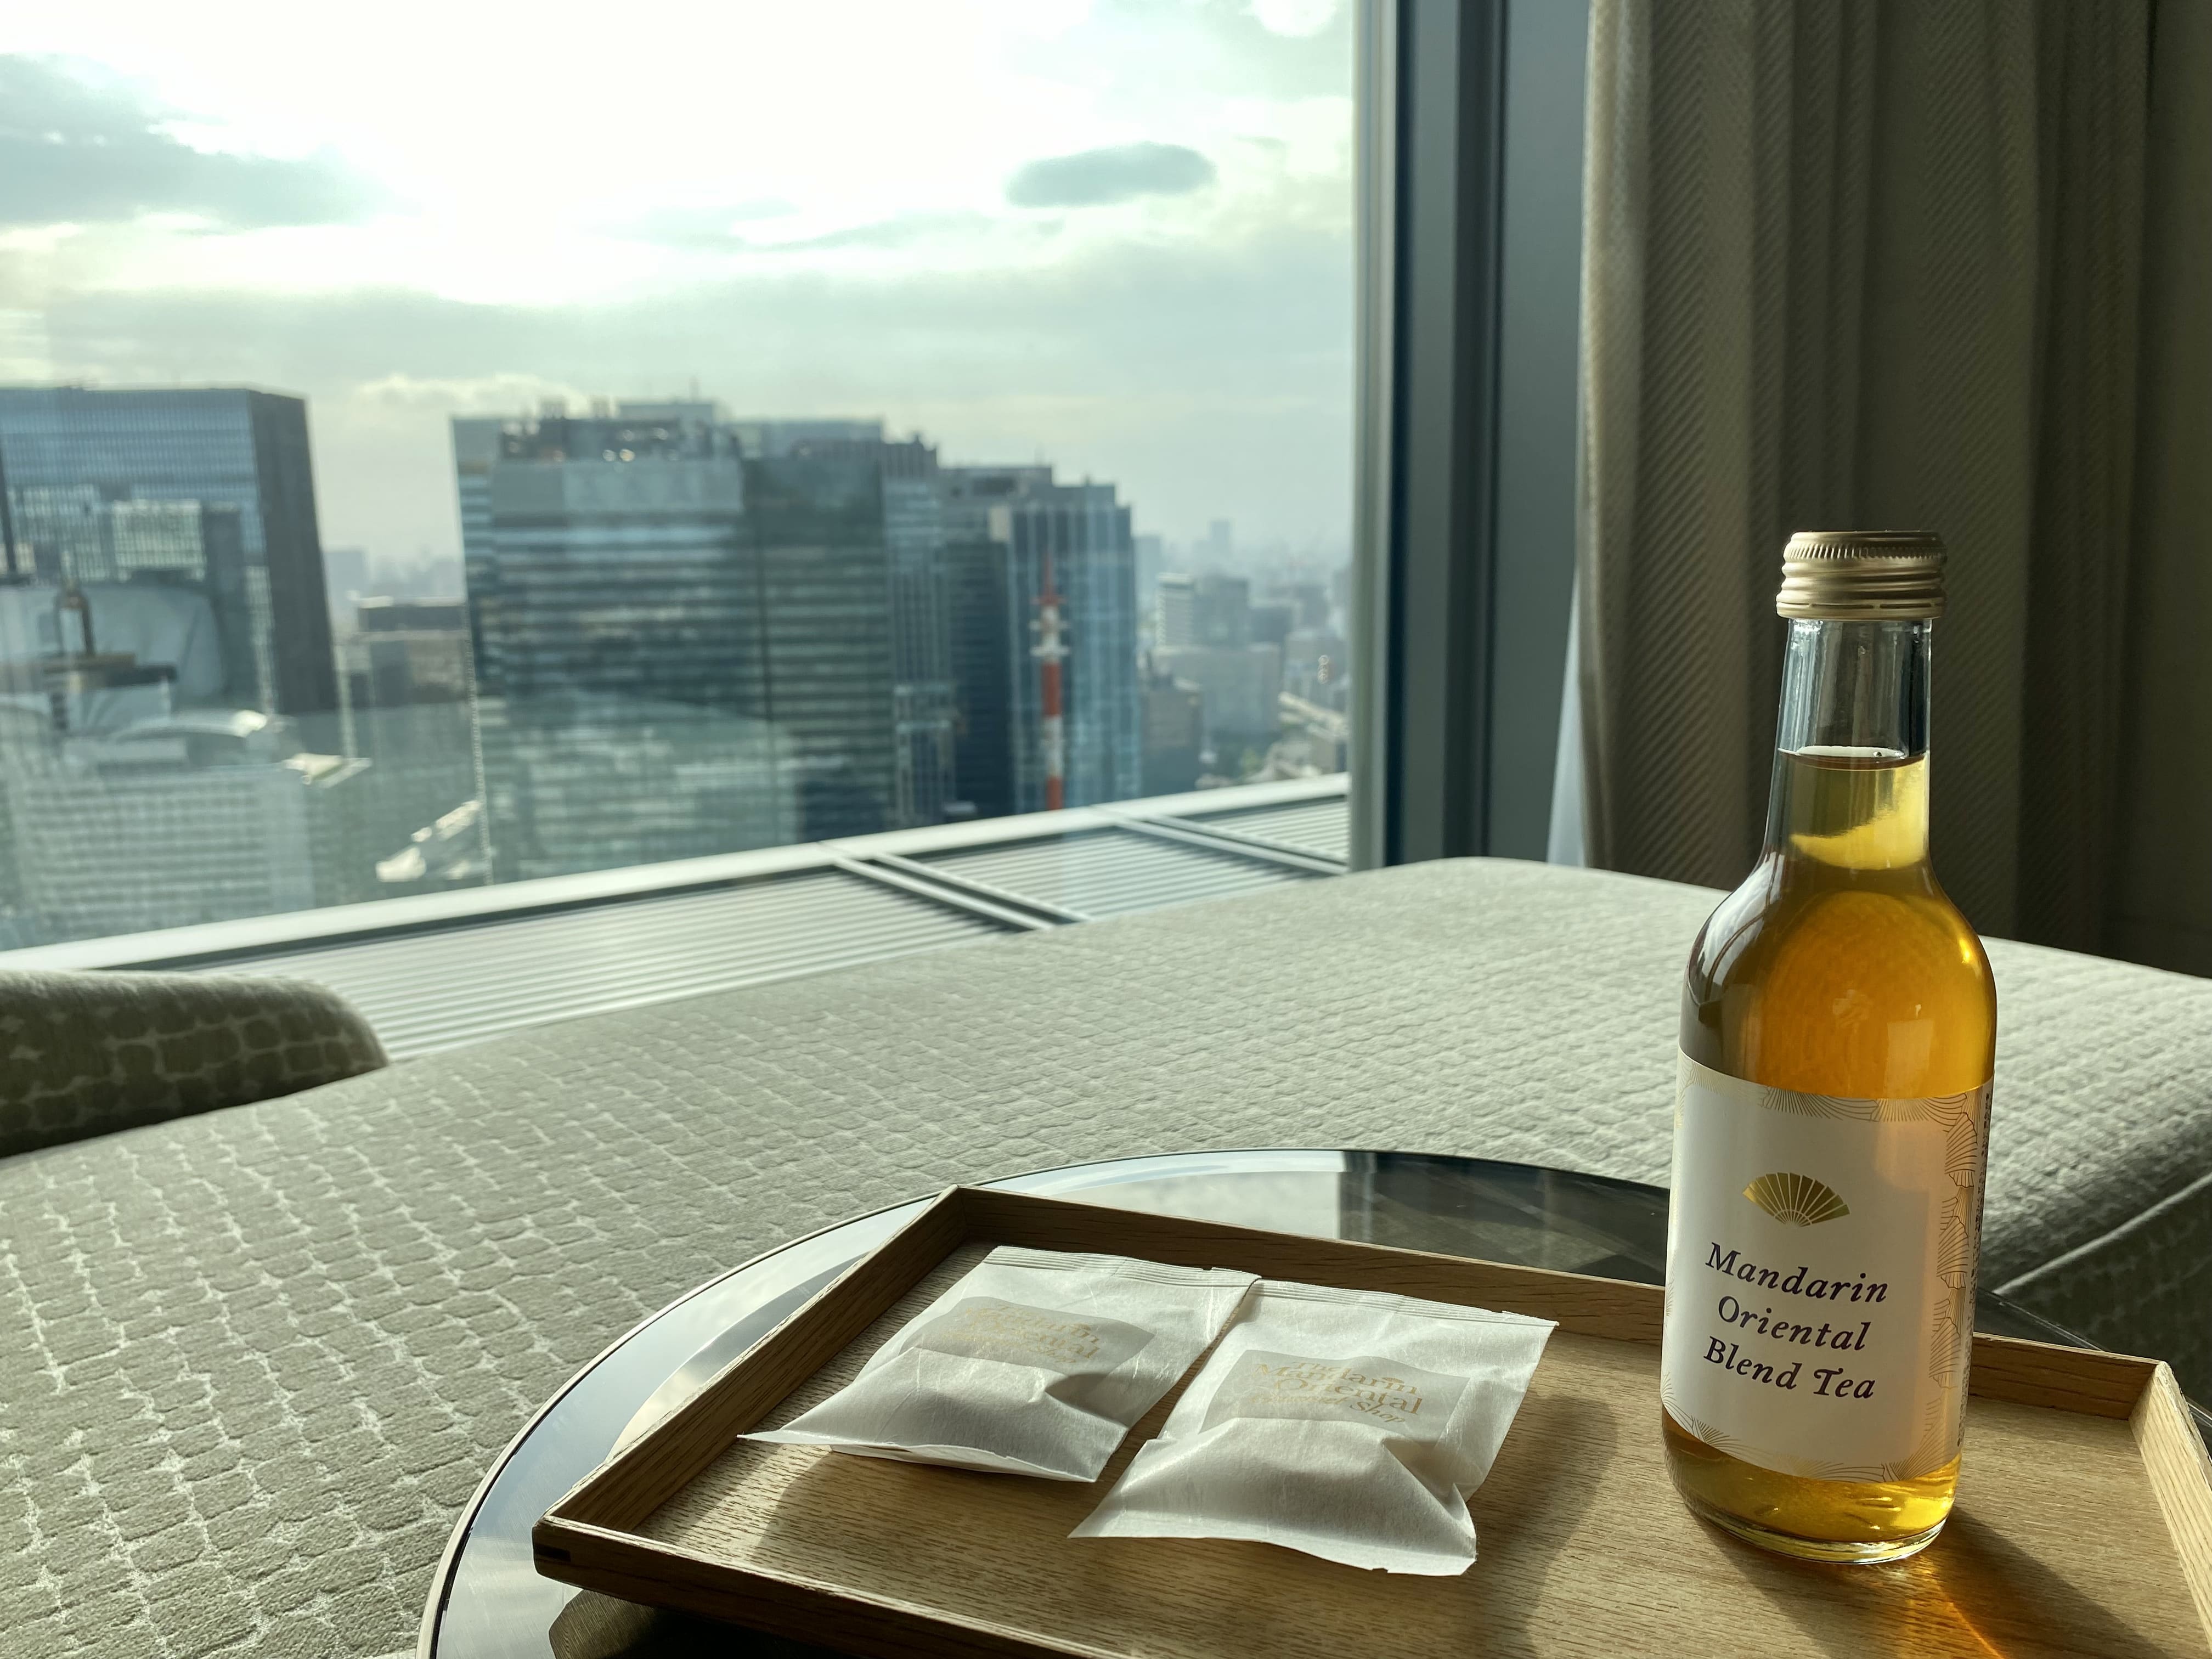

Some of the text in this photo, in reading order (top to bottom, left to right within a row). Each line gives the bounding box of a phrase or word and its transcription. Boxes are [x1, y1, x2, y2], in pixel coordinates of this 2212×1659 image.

[1705, 1242, 1888, 1303] Mandarin
[1718, 1295, 1871, 1351] Oriental
[1252, 1363, 1418, 1395] Mandarin
[1703, 1336, 1876, 1399] Blend Tea
[1274, 1378, 1423, 1415] Oriental
[1349, 1401, 1406, 1423] Shop
